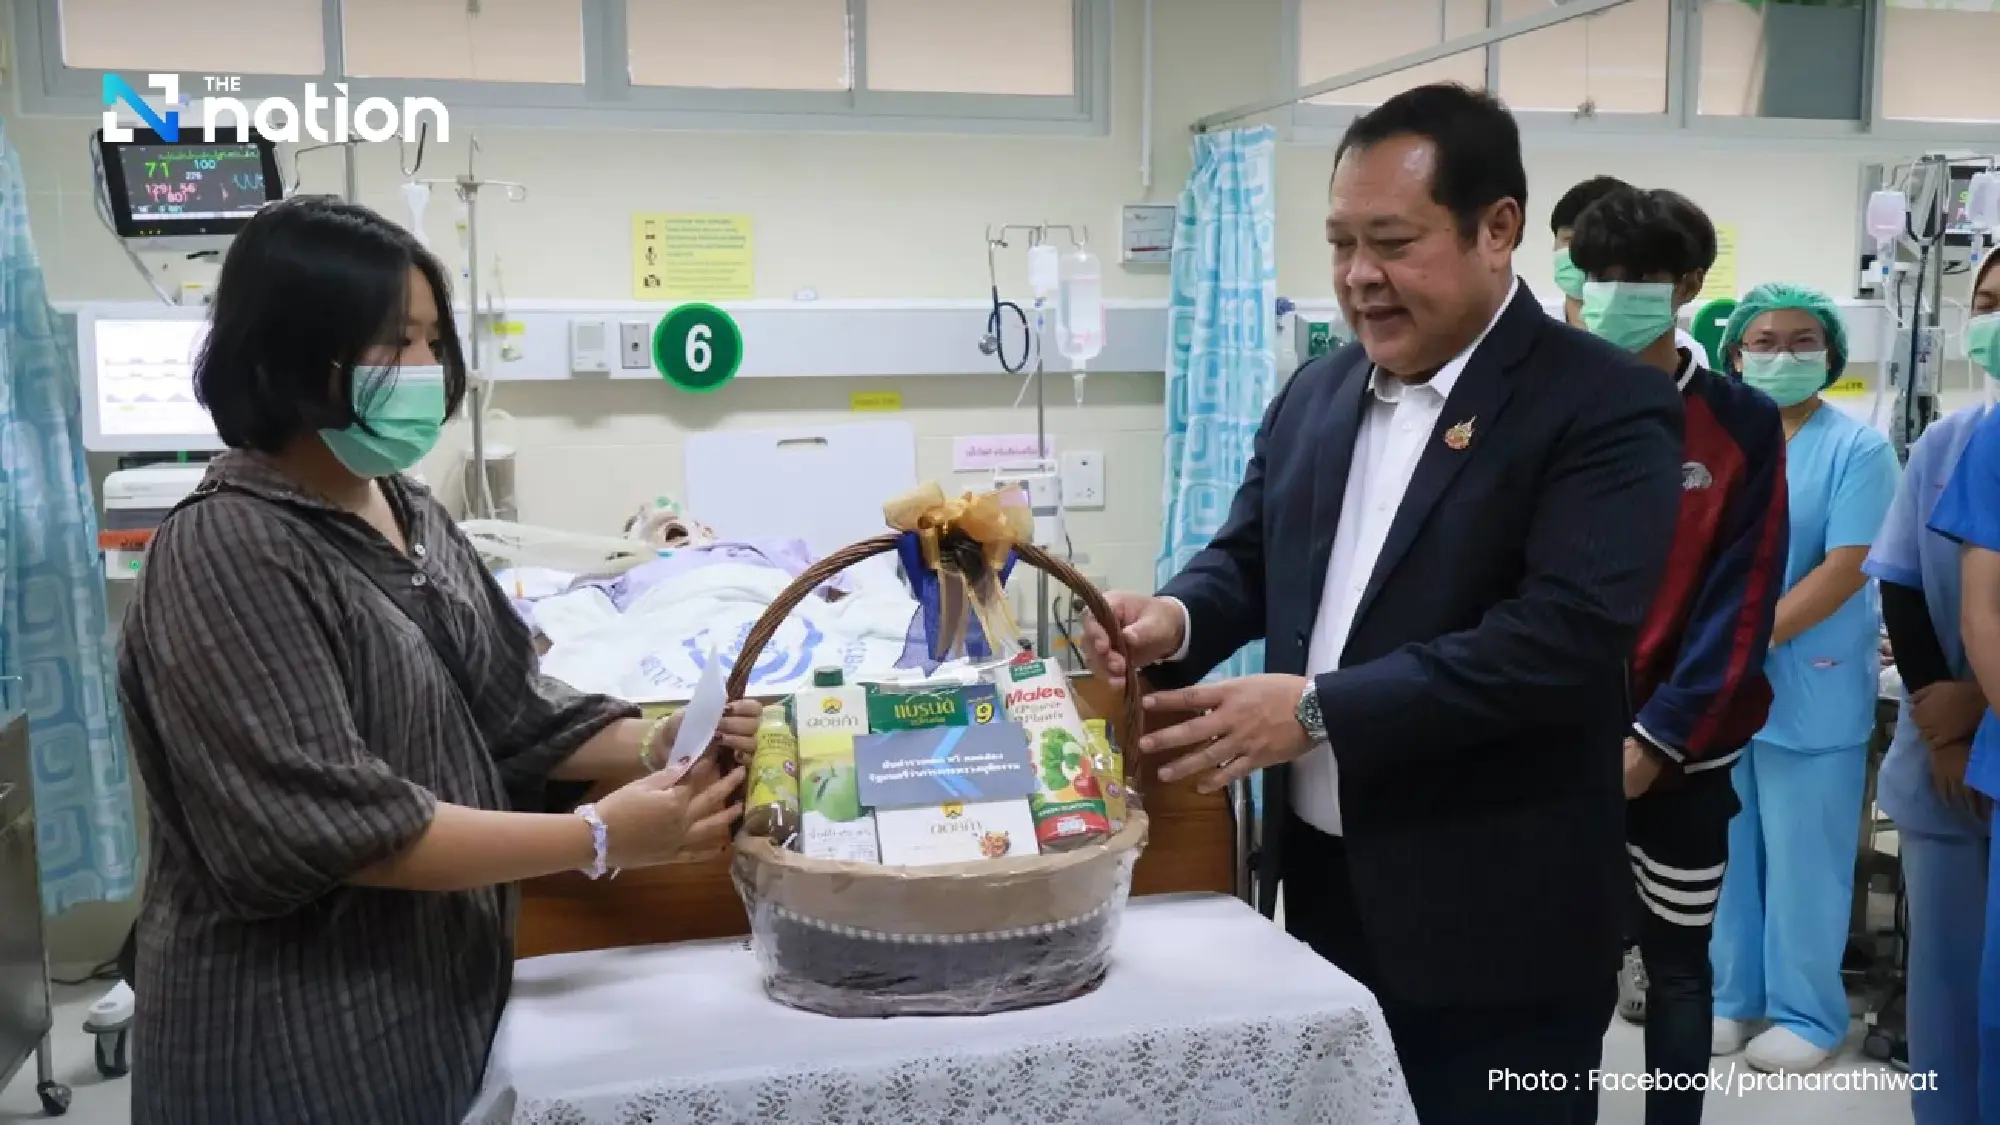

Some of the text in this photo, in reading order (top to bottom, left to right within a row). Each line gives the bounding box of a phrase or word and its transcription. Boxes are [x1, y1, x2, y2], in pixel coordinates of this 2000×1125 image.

[144, 160, 169, 178] 71
[193, 159, 216, 170] 100
[685, 323, 712, 373] 6
[1005, 686, 1066, 707] Malee
[974, 701, 995, 725] 9
